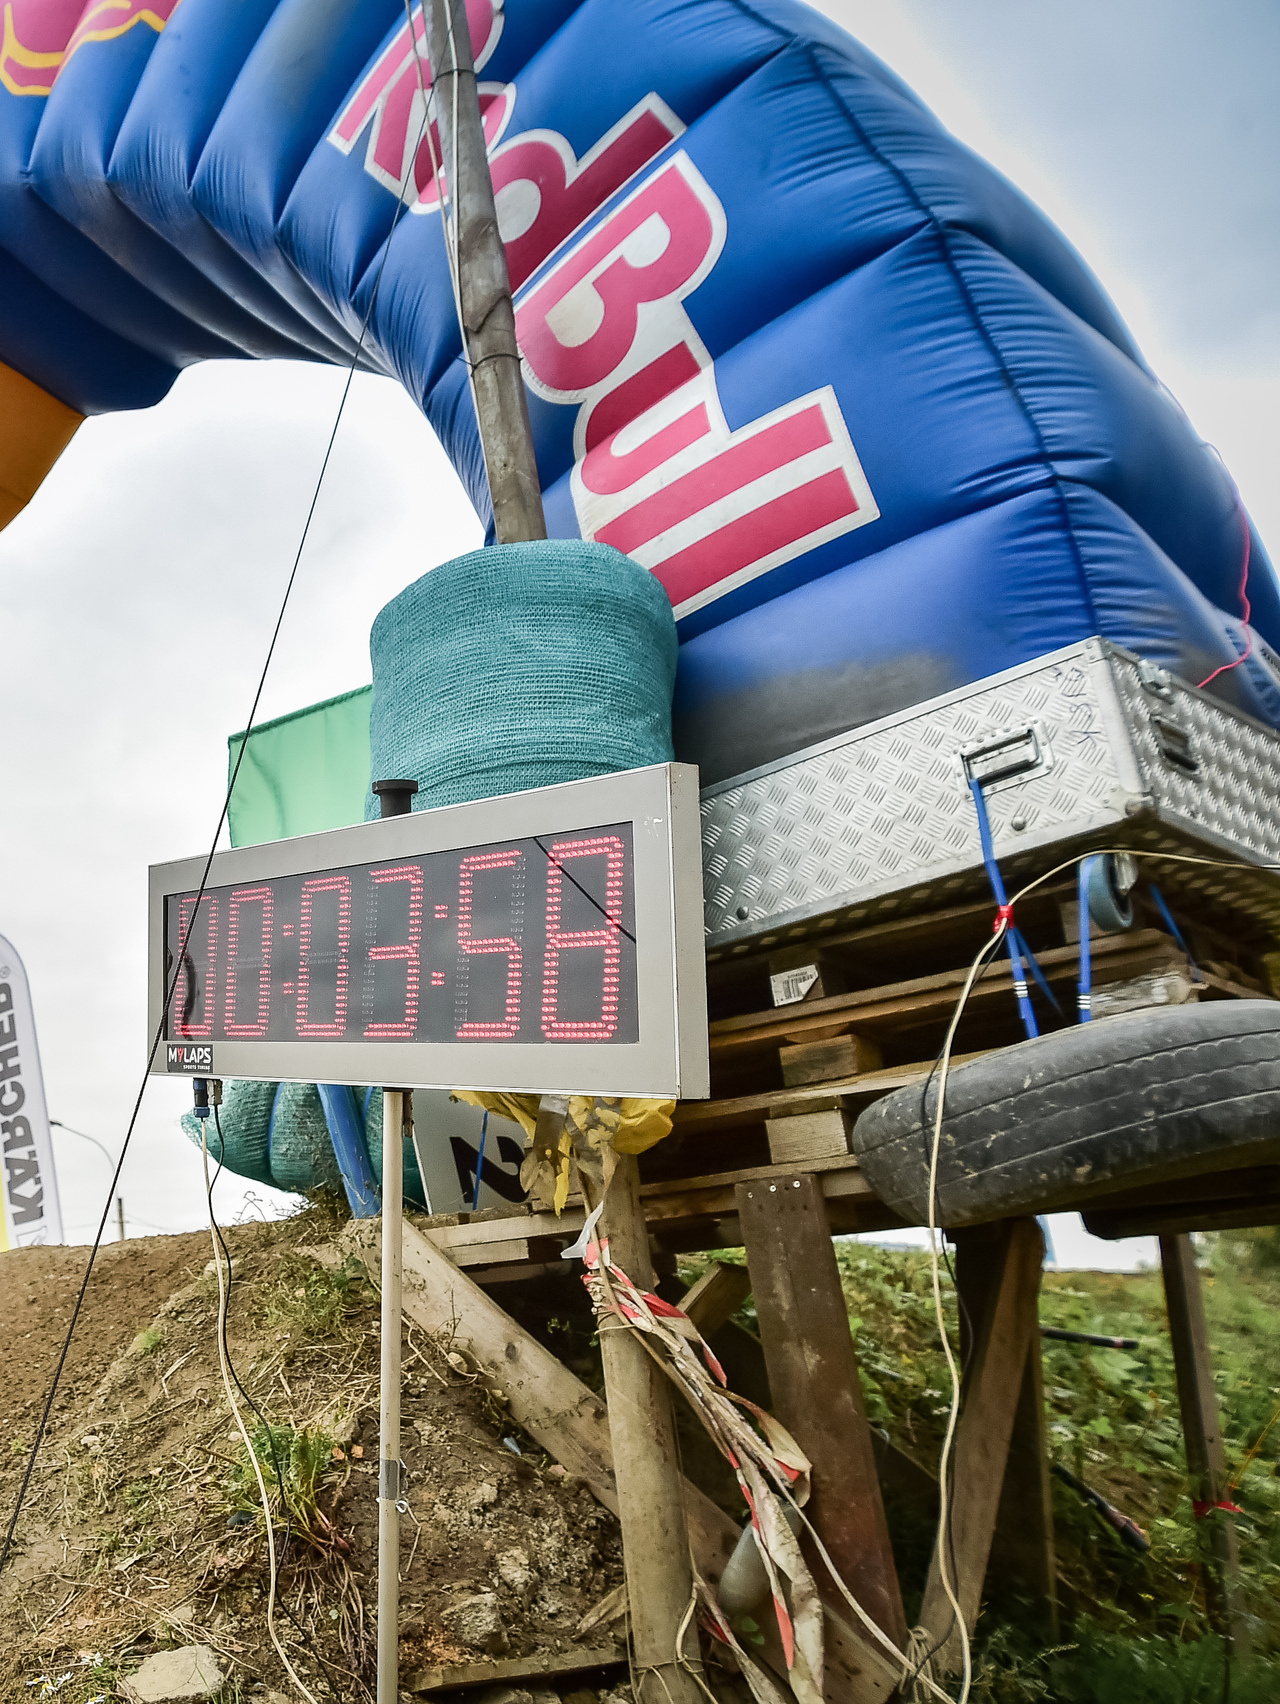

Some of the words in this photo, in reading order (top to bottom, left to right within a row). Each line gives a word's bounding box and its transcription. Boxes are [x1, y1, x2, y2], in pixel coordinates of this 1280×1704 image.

[515, 150, 879, 619] Bull
[174, 836, 625, 1040] 00:03:58
[168, 1047, 211, 1063] MYLAPS
